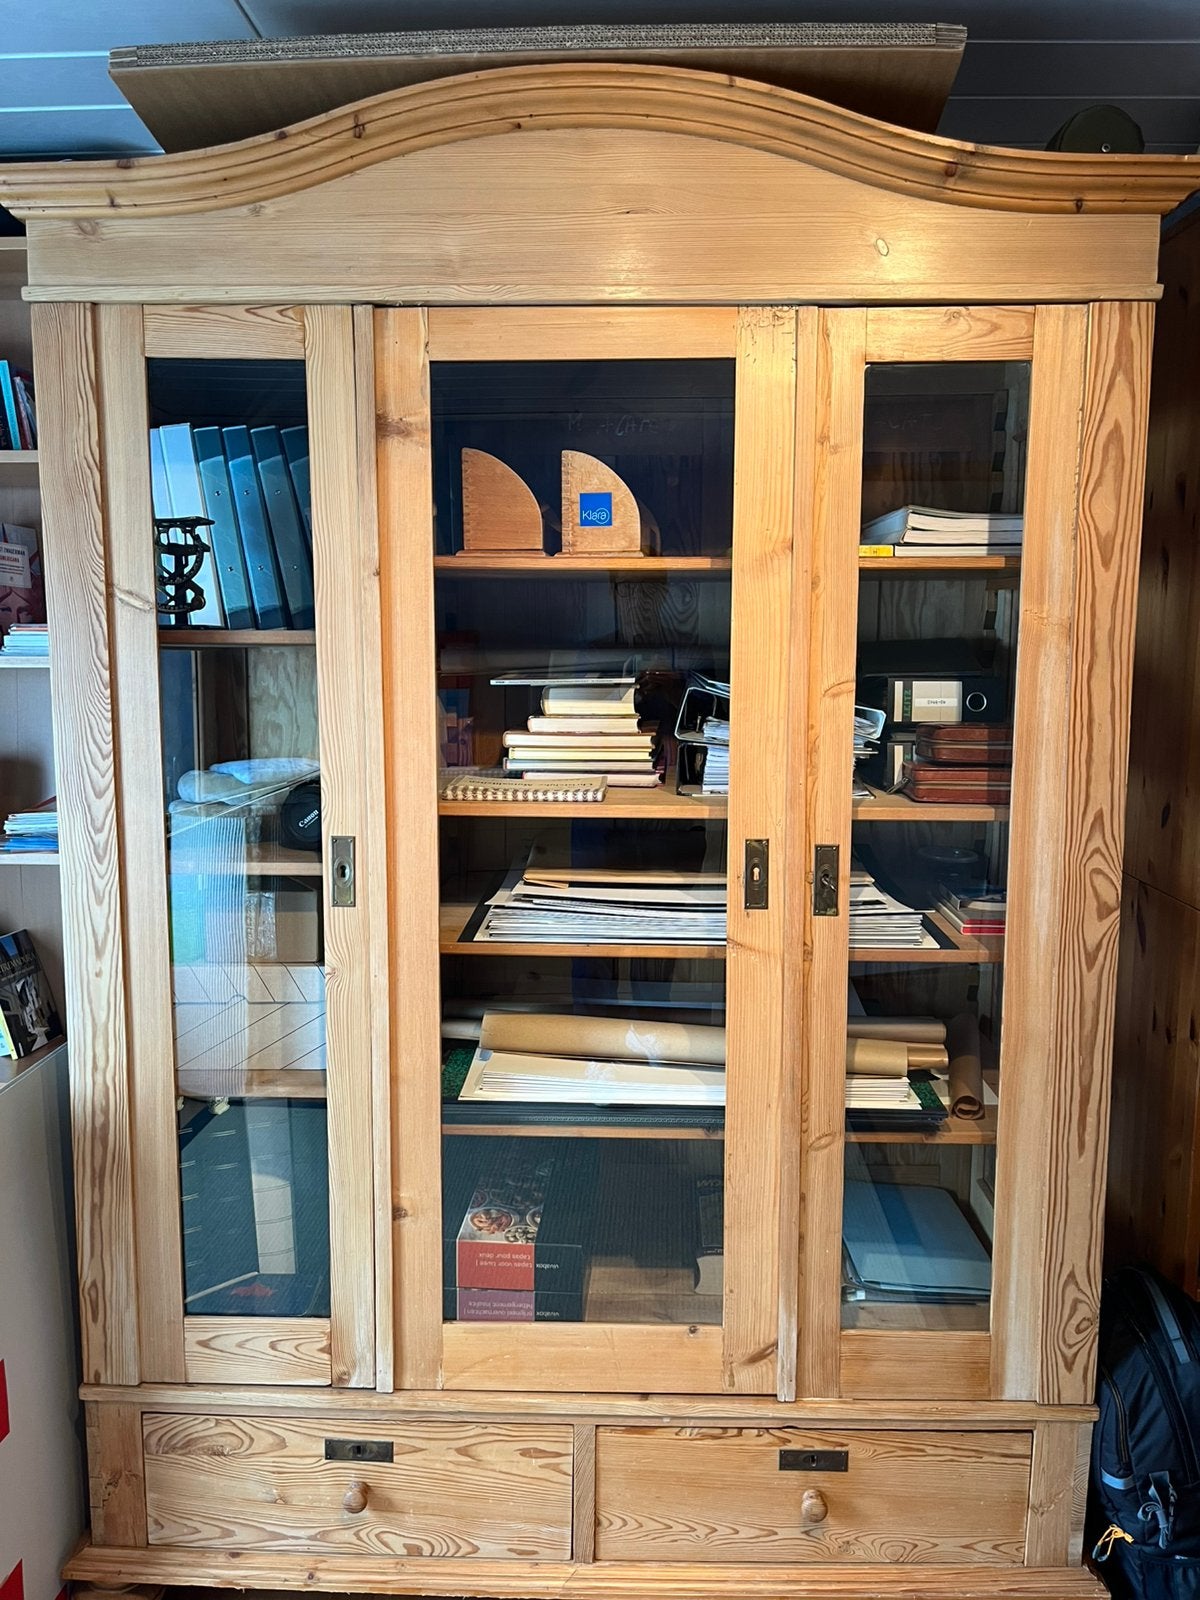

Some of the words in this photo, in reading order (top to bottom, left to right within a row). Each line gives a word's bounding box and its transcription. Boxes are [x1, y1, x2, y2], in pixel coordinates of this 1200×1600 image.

[582, 510, 608, 520] Klara
[298, 809, 319, 828] Canon
[513, 1261, 533, 1269] tapas
